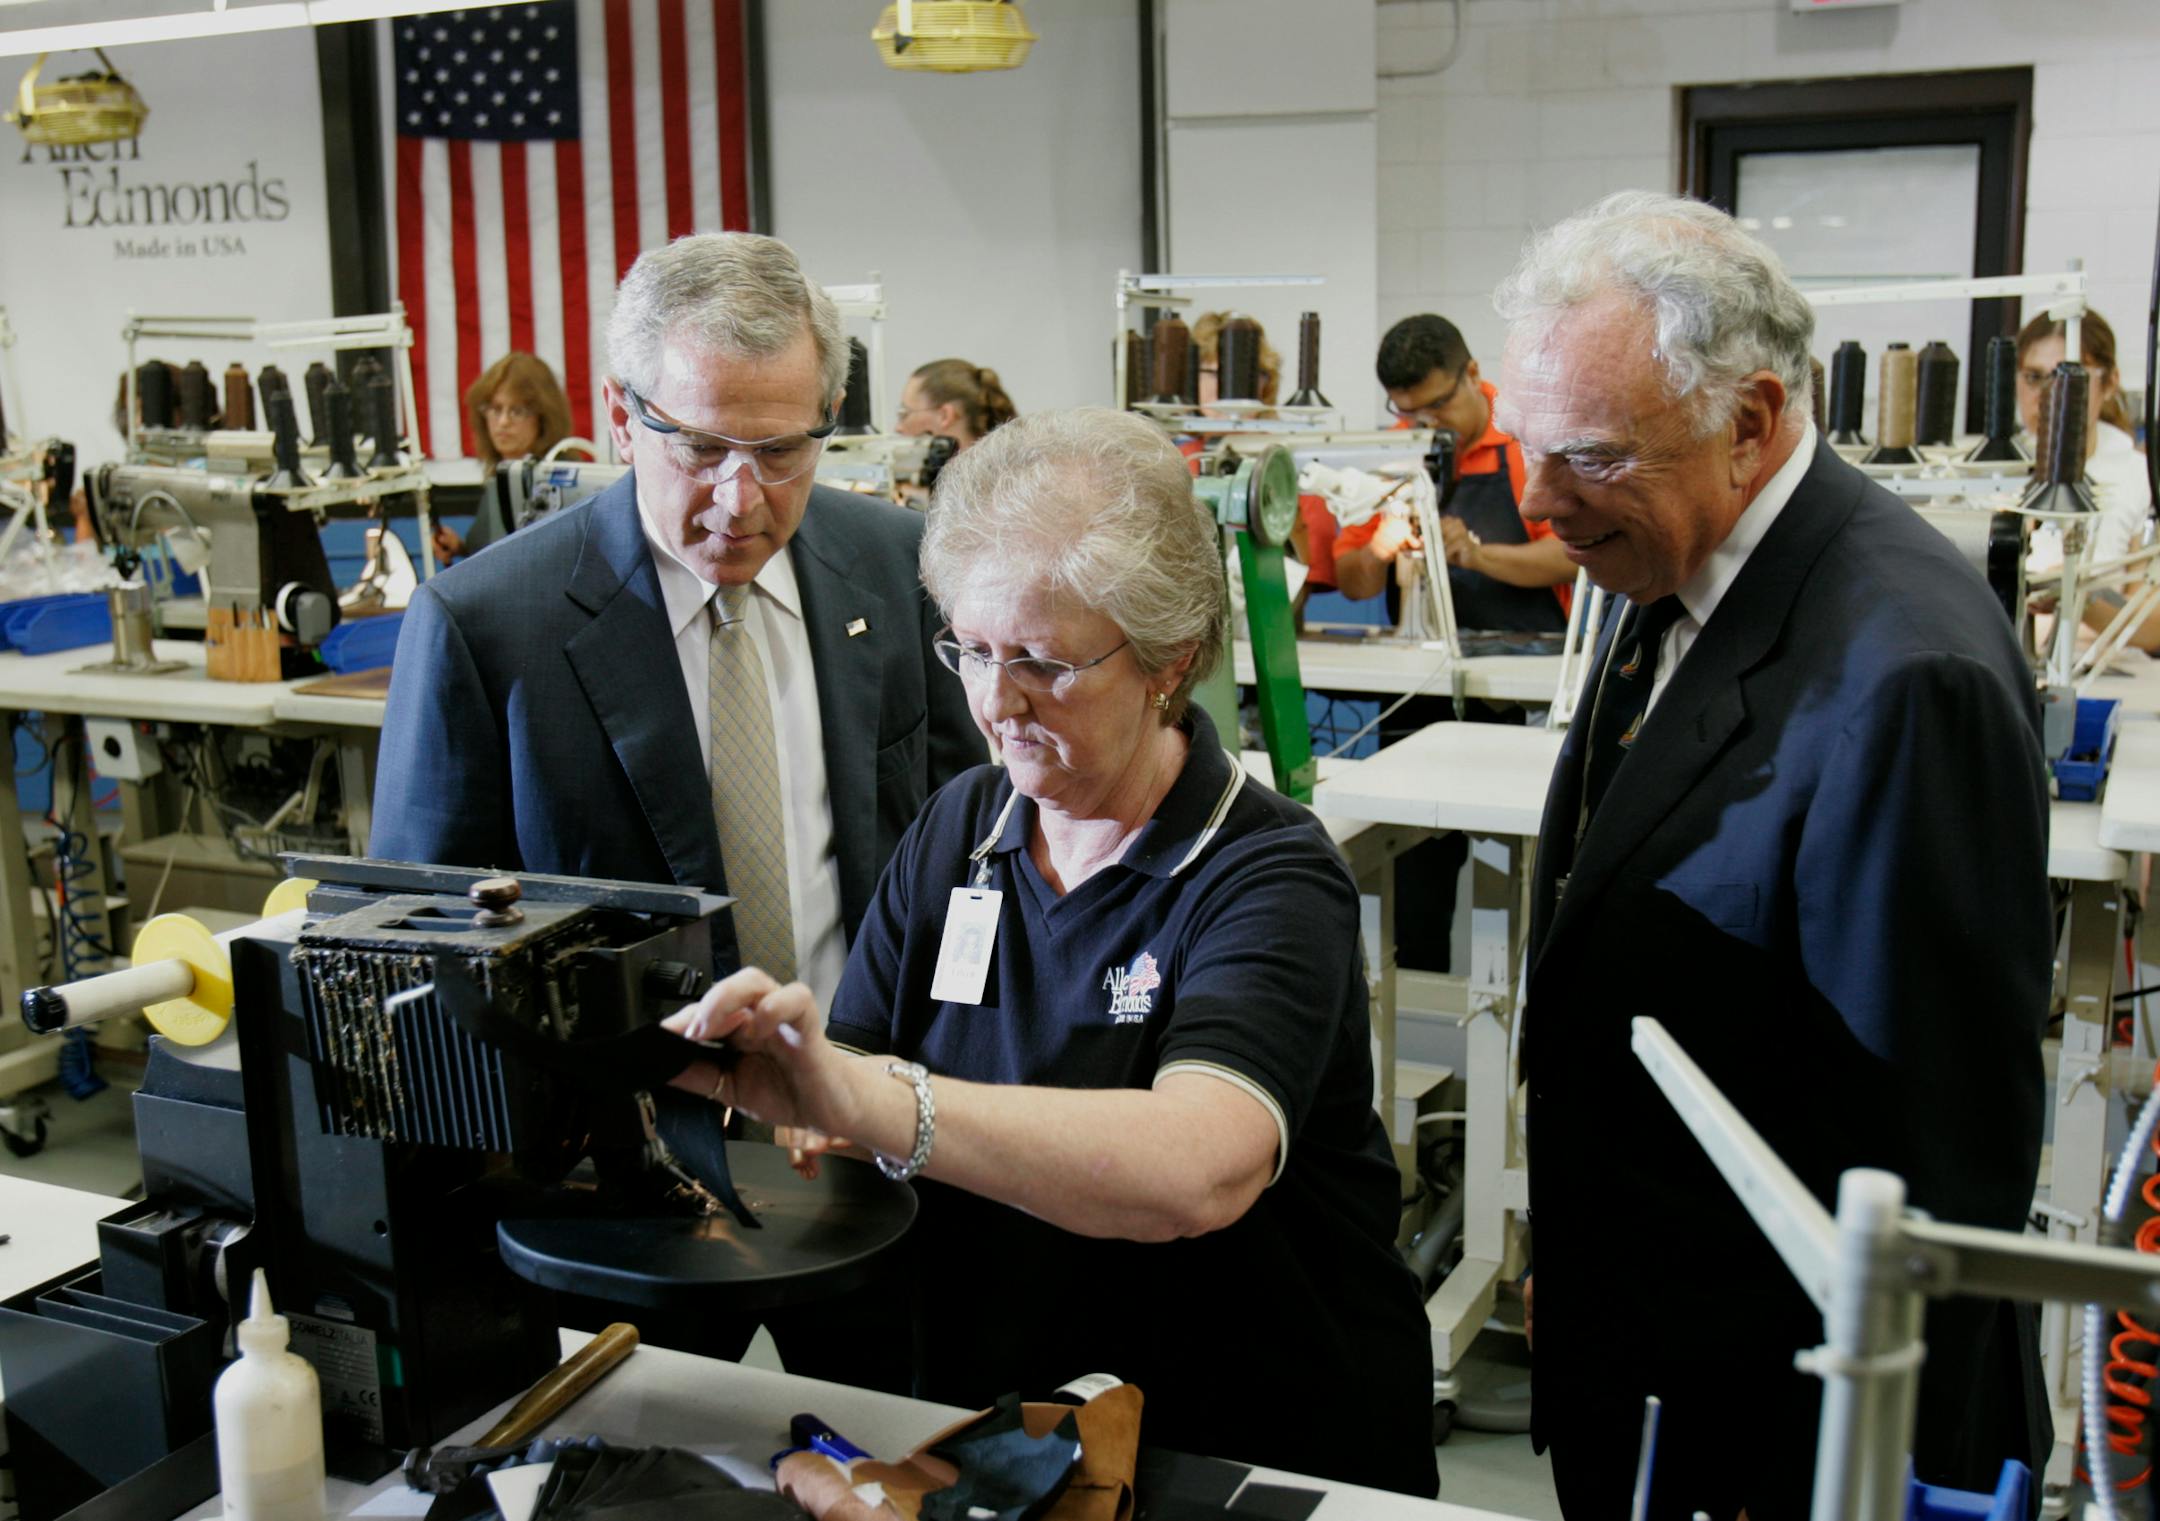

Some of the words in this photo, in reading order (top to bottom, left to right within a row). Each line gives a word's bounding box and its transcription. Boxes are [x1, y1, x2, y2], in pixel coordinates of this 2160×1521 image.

[58, 159, 291, 228] Edmonds
[114, 237, 171, 260] Made
[175, 236, 197, 258] in
[202, 234, 247, 257] USA
